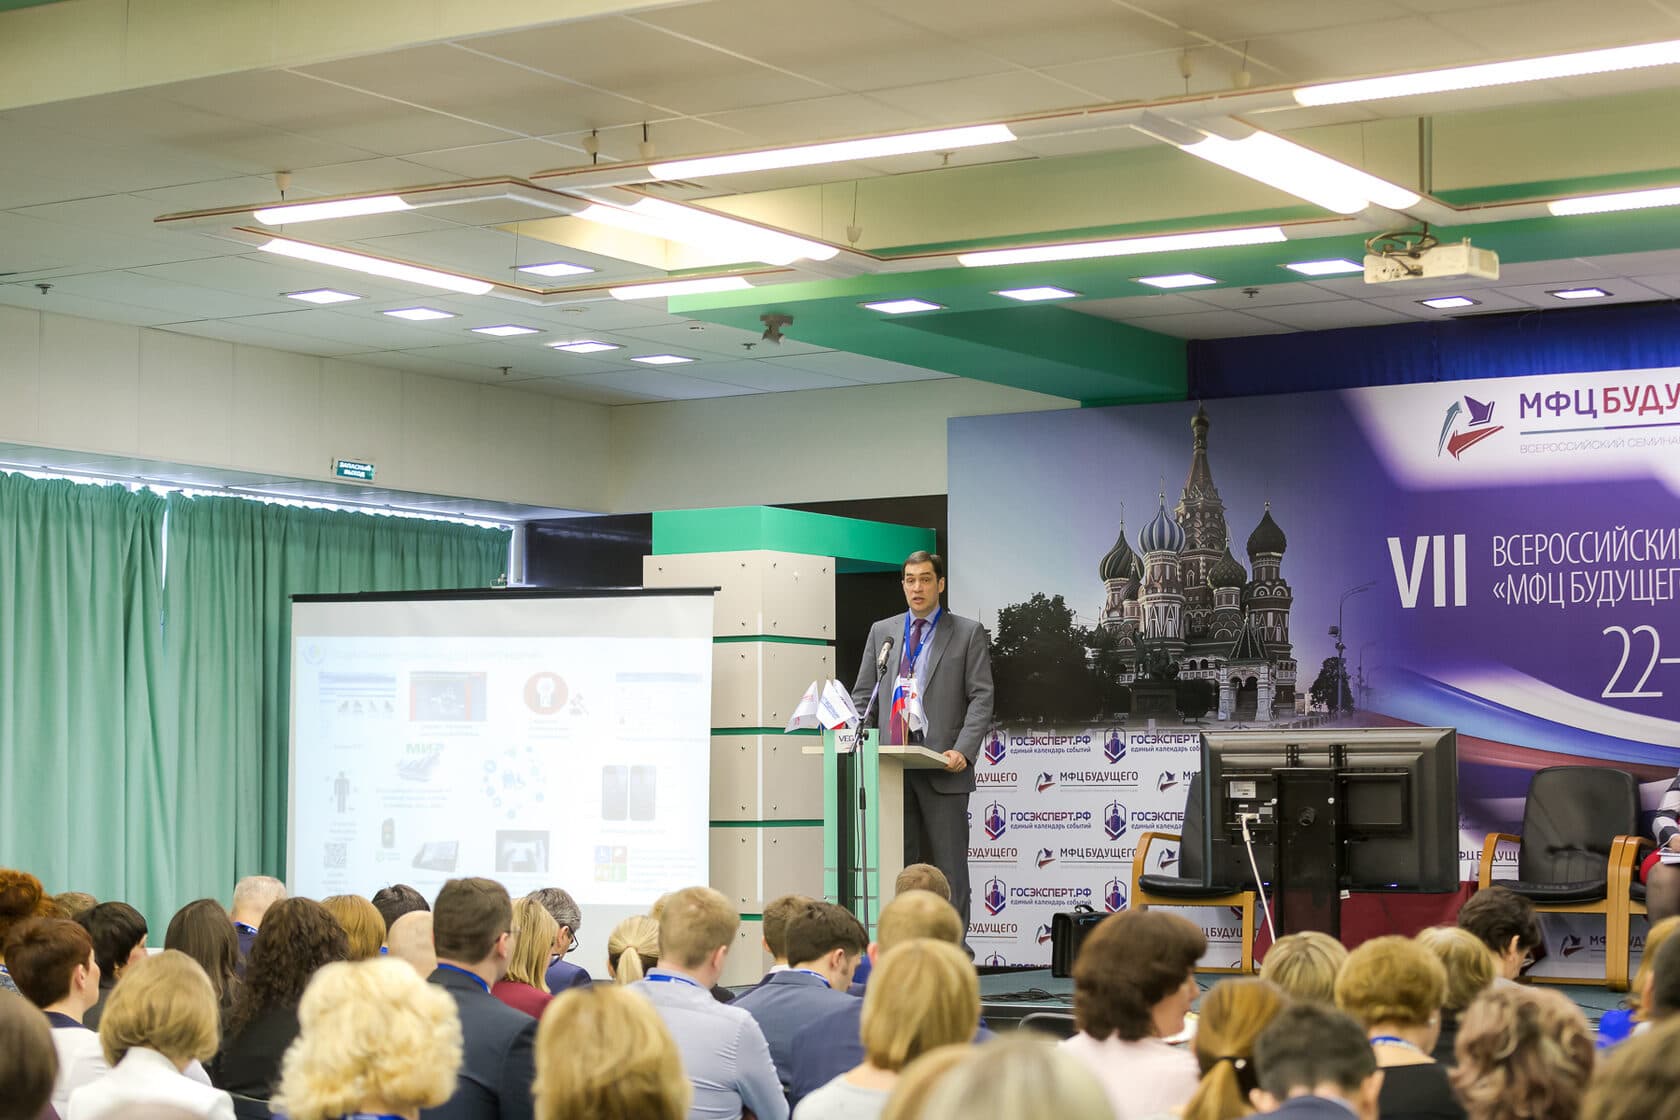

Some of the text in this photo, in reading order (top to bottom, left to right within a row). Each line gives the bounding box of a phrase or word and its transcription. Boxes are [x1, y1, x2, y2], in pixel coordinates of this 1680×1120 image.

[1627, 435, 1680, 448] СЕМИНА
[1493, 525, 1680, 567] ВСЕРОССИЙСКИ
[1386, 534, 1467, 609] VII
[1571, 568, 1680, 608] БУДУЩЕГ
[838, 735, 855, 743] VEG
[1010, 735, 1091, 746] ГОСЭКСПЕРТ.РФ
[1060, 771, 1138, 782] МФЦБУДУЩЕГО
[1010, 811, 1091, 821] ГОСЭКСПЕРТ.РФ
[1010, 887, 1092, 897] ГОСЭКСПЕРТ.РФ
